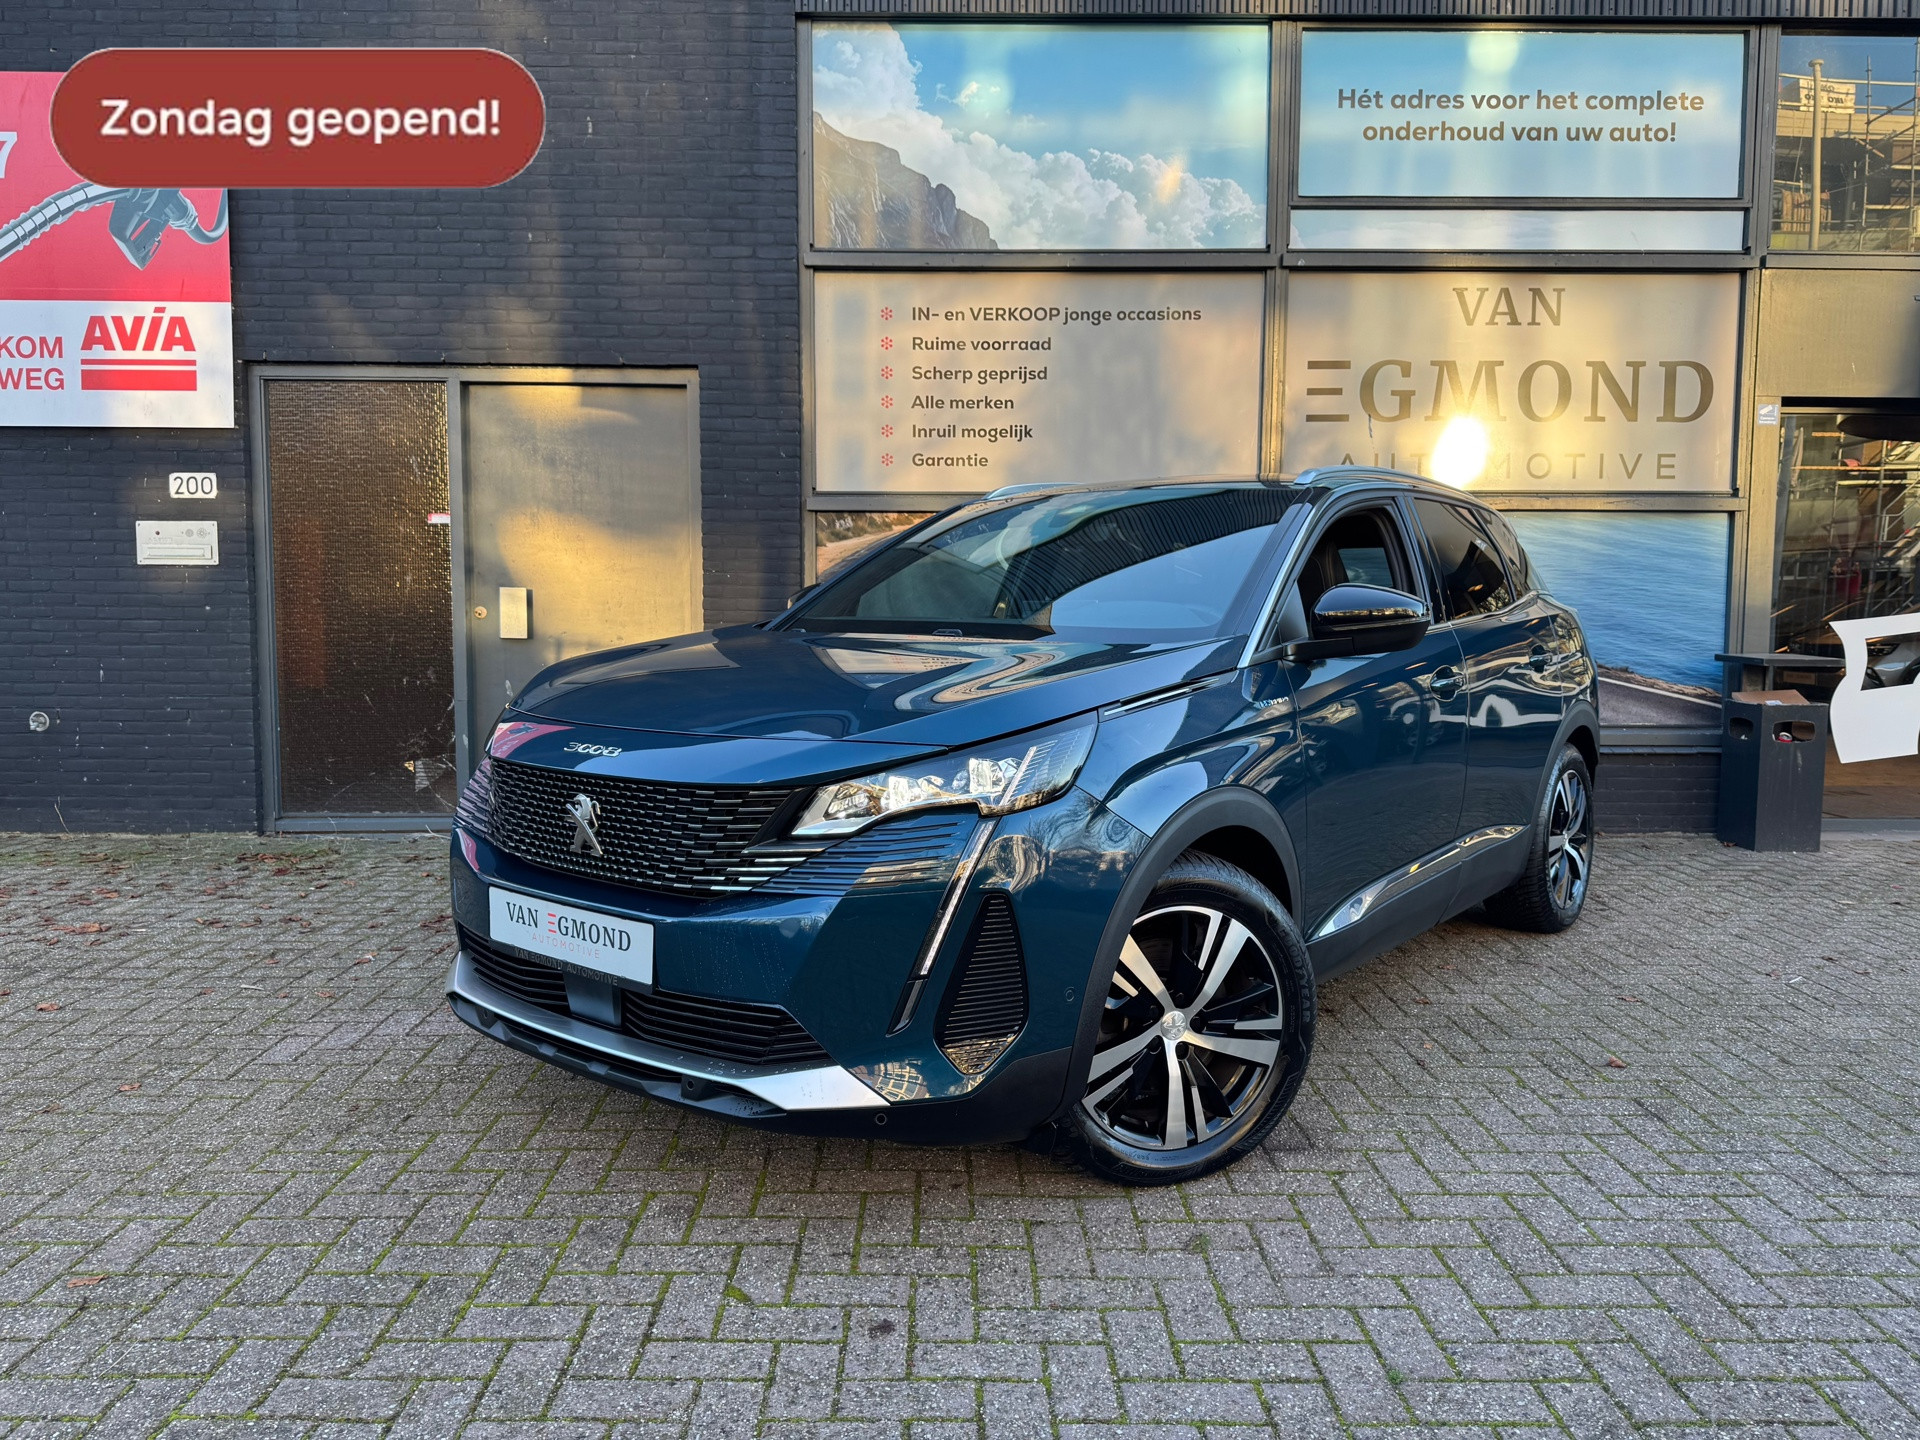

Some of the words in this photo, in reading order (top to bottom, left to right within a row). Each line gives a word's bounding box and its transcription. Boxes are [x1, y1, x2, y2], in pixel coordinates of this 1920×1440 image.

[1337, 88, 1383, 110] Hét
[1390, 89, 1465, 111] adres
[1471, 94, 1529, 111] voor
[1536, 90, 1579, 111] het
[1585, 90, 1705, 117] complete
[1362, 121, 1505, 142] onderhoud
[1511, 127, 1559, 142] van
[1565, 127, 1603, 142] uw
[1609, 123, 1677, 143] auto!
[911, 306, 940, 322] IN-
[945, 310, 965, 322] en
[969, 306, 1061, 322] VERKOOP
[1063, 307, 1112, 326] jonge
[1116, 306, 1202, 322] occasions
[1452, 286, 1566, 327] VAN
[911, 336, 966, 352] Ruime
[970, 336, 1052, 352] voorraad
[0, 367, 65, 390] WEG
[911, 365, 973, 383] Scherp
[977, 365, 1048, 385] geprijsd
[911, 395, 945, 410] Alle
[949, 395, 1015, 410] merken
[911, 424, 957, 440] Inruil
[961, 424, 1034, 443] mogelijk
[911, 453, 989, 469] Garantie
[1339, 452, 1677, 480] TOTIVE
[173, 476, 213, 495] 200
[563, 741, 622, 757] 3008
[506, 901, 539, 929] VAN
[547, 912, 632, 952] EGMOND
[531, 932, 600, 959] AUTOMOTIVE
[566, 962, 618, 987] AUTOMOTIVE
